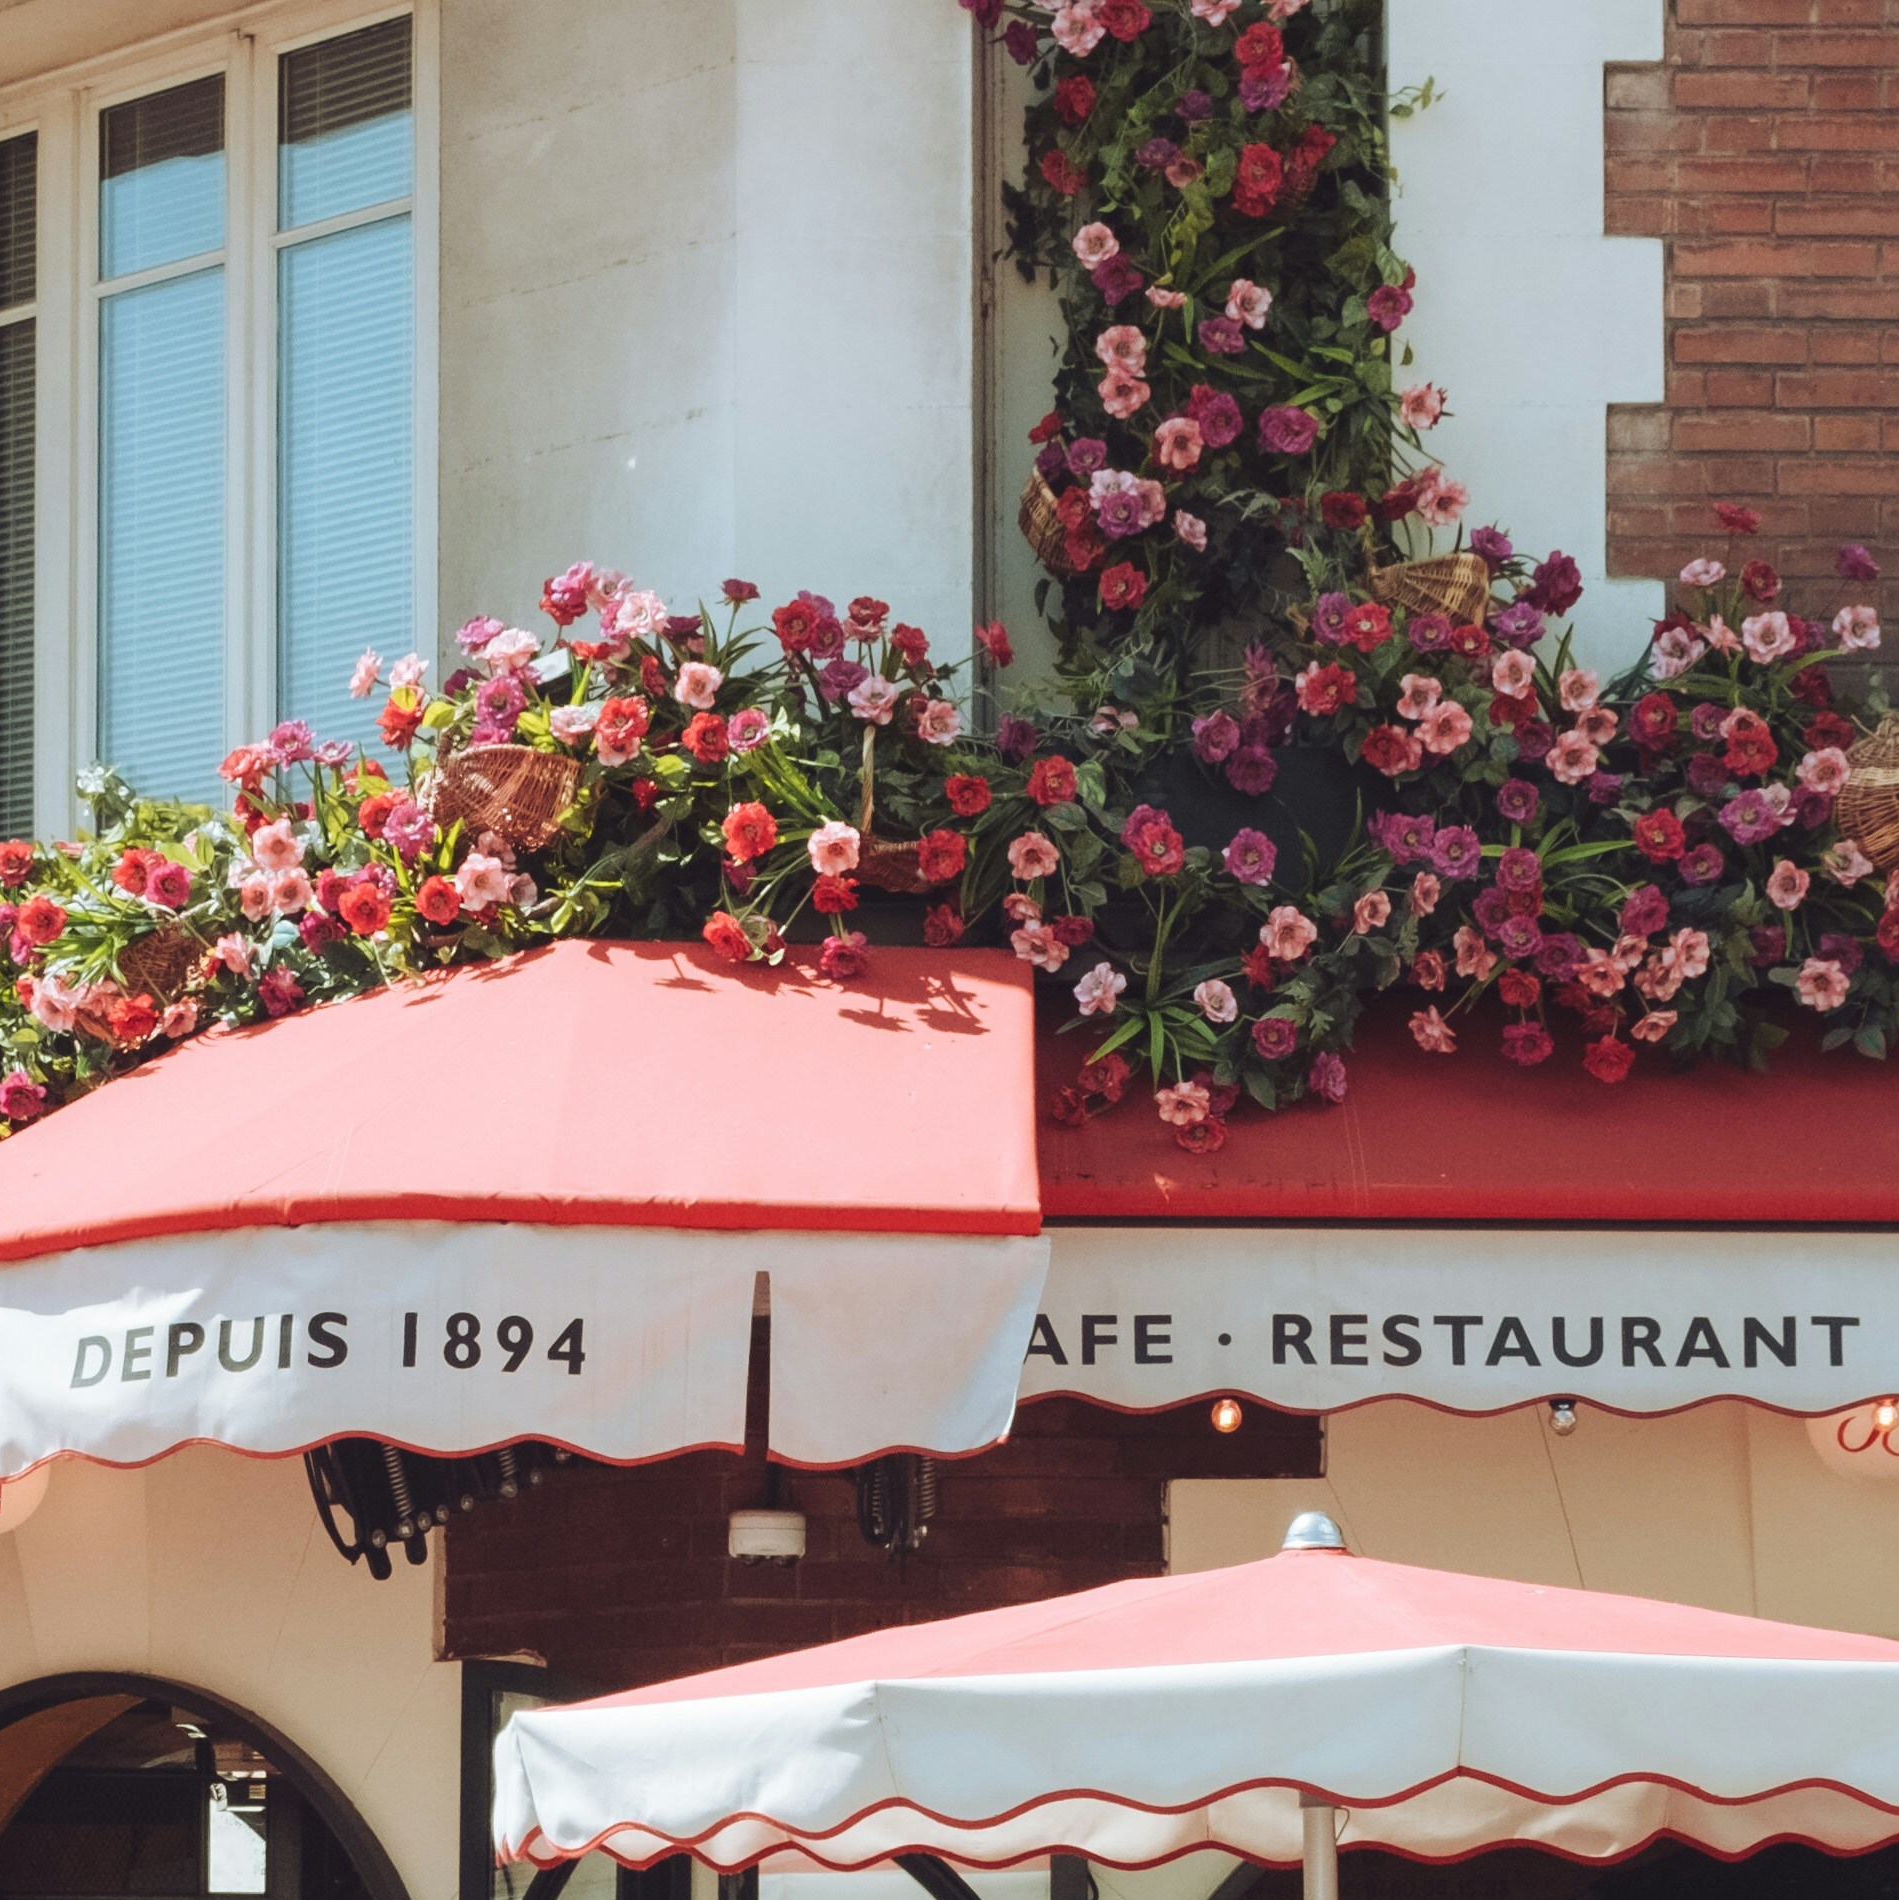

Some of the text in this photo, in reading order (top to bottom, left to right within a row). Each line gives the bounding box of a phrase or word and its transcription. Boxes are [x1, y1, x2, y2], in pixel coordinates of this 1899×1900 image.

[69, 1311, 587, 1389] DEPUIS 1894
[1272, 1313, 1860, 1368] RESTAURANT
